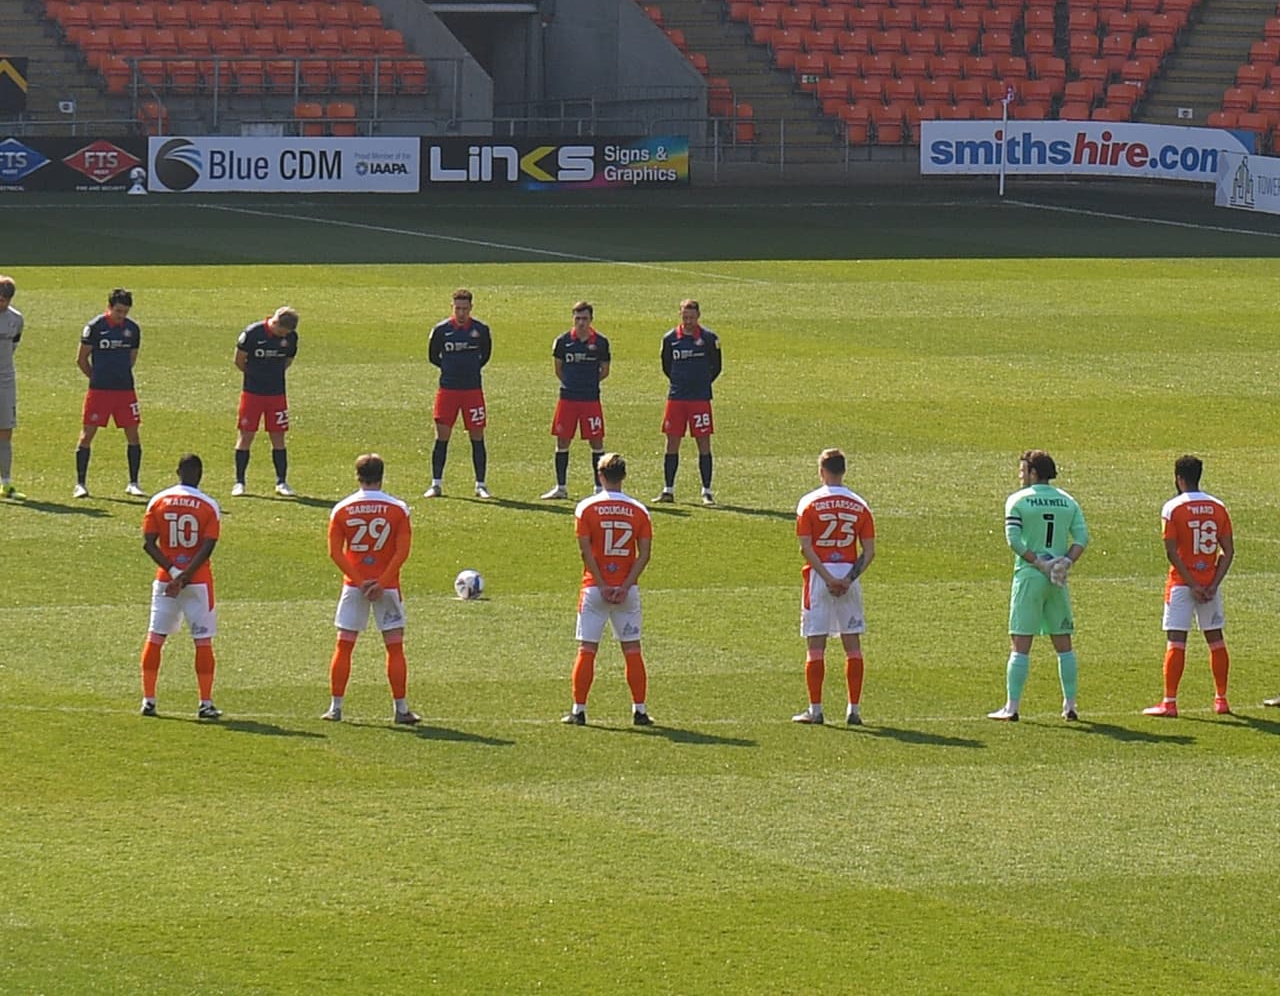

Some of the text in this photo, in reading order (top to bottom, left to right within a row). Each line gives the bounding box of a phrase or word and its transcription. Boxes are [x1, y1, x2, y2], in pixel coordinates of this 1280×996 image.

[84, 151, 119, 169] FTS
[604, 145, 668, 163] Signs &
[209, 150, 342, 180] Blue CDM
[370, 162, 408, 175] IAAPA
[604, 165, 677, 185] Graphics
[470, 407, 486, 421] 25
[588, 417, 602, 429] 14
[347, 504, 389, 515] GARBUTT
[596, 505, 634, 517] DOUGALL
[1029, 497, 1069, 508] MAXWELL
[1190, 506, 1215, 515] WARD
[164, 513, 199, 548] 10
[346, 518, 391, 552] 29
[600, 521, 633, 556] 12
[815, 514, 858, 547] 23
[1043, 514, 1055, 548] 1
[1188, 520, 1218, 555] 18
